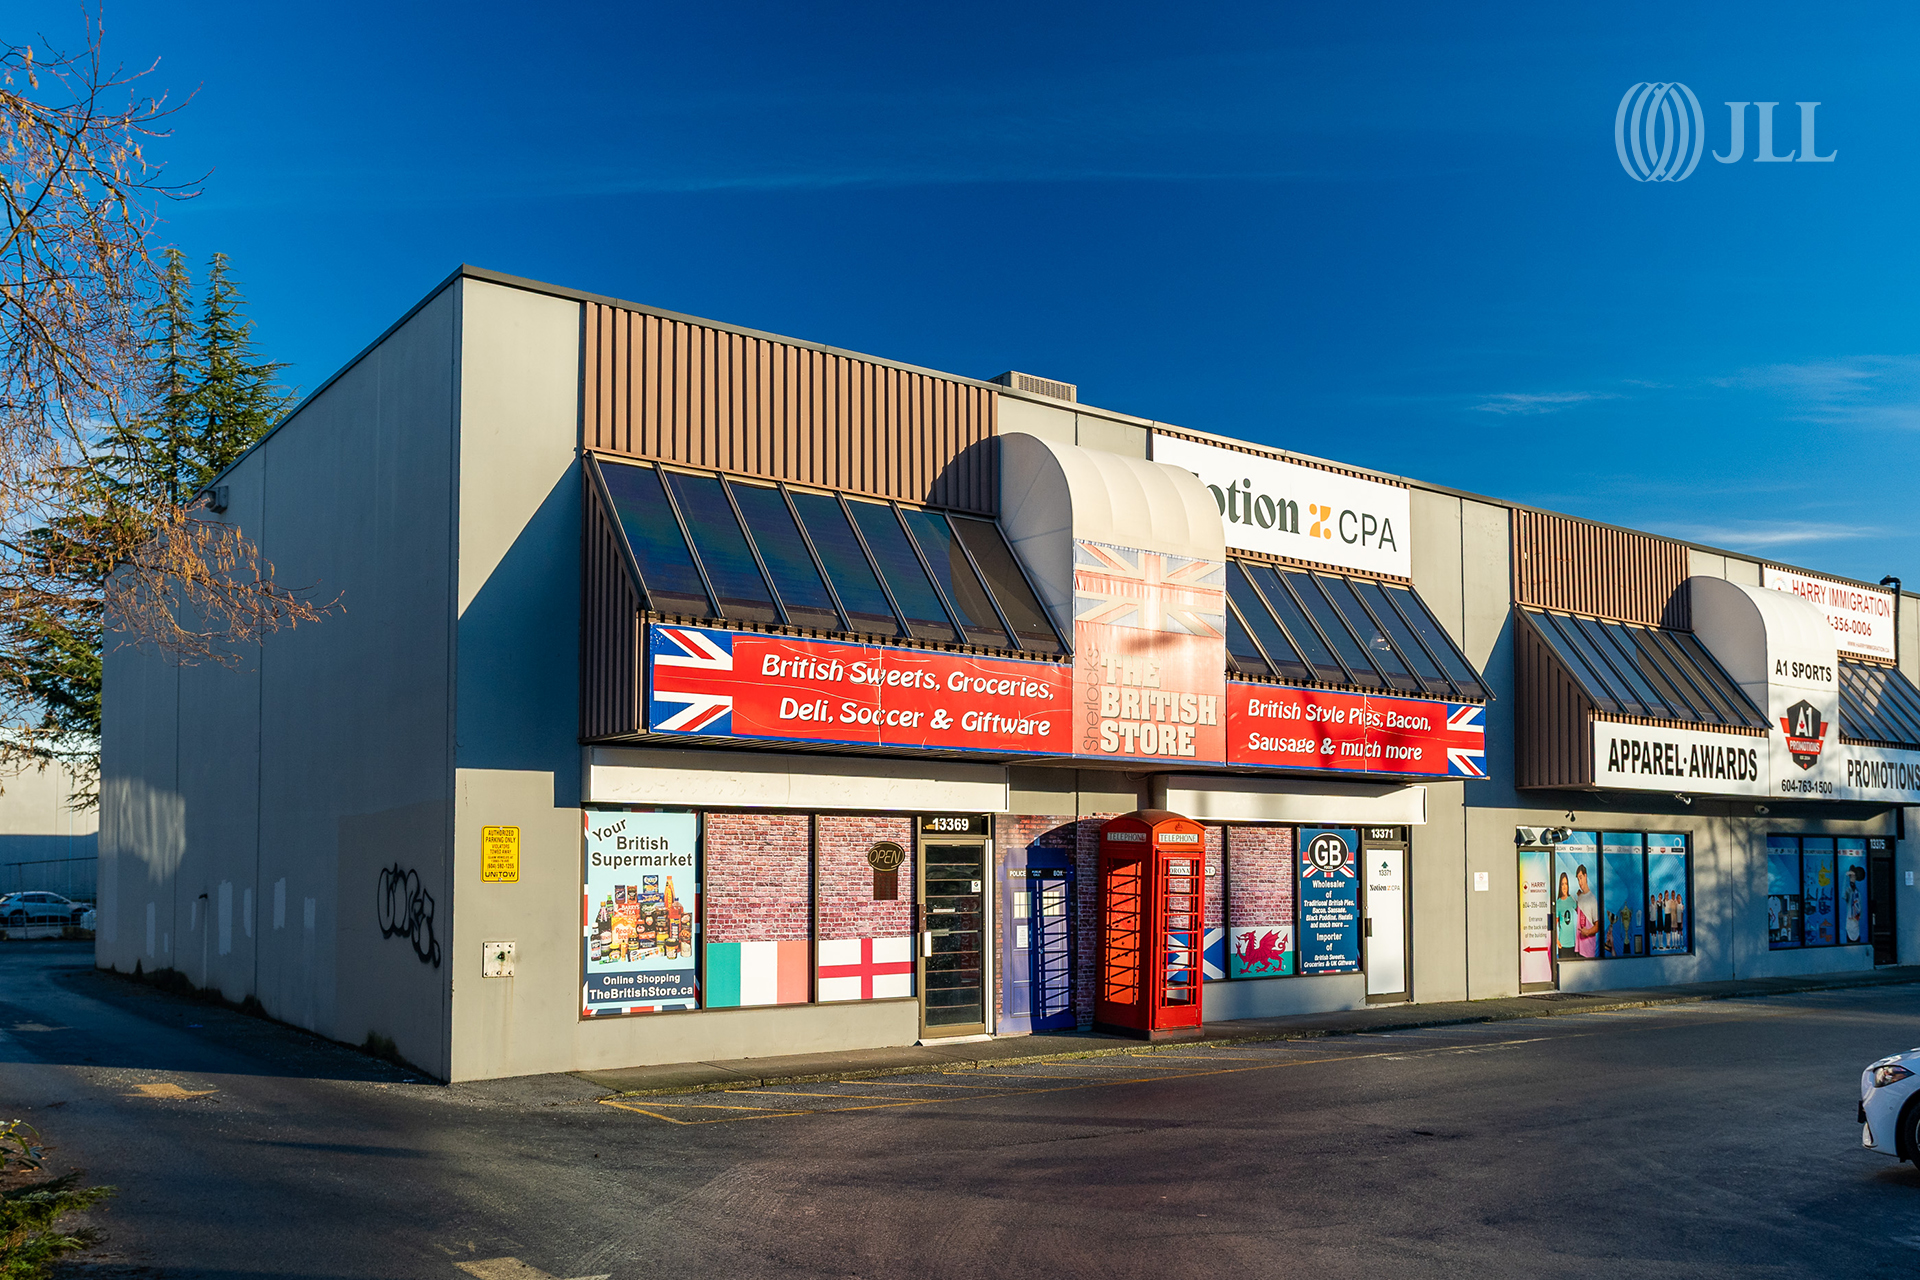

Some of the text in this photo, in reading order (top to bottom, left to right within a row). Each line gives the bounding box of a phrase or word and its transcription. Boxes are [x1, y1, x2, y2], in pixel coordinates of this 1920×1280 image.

[1206, 477, 1397, 552] otion CPA
[1792, 579, 1890, 618] HARRY IMMIGRATION
[761, 653, 1054, 701] British Sweets, Groceries,
[1101, 653, 1161, 688] THE
[1775, 659, 1832, 683] A1 SPORTS
[1083, 647, 1099, 752] Sherlock's
[1100, 686, 1218, 726] BRITISH
[779, 697, 1051, 737] Deli, Soccer & Giftware
[1248, 699, 1432, 732] British Style Pies, Bacon,
[1795, 706, 1813, 737] A1
[1100, 720, 1196, 757] STORE
[1789, 740, 1820, 752] PROMOTIONS
[1248, 732, 1422, 761] Sausage & much more
[1847, 759, 1920, 791] PROMOTIONS
[1781, 779, 1833, 794] 604-763-1500
[592, 819, 626, 841] Your
[932, 817, 969, 831] 13369
[1109, 833, 1145, 841] TELEPHONE
[1160, 834, 1196, 842] TELEPHONE
[1371, 828, 1394, 839] 13371
[617, 836, 669, 850] British
[1869, 838, 1886, 850] 13375
[869, 849, 901, 864] OPEN
[1314, 839, 1342, 866] GB
[592, 852, 692, 870] Supermarket
[1169, 866, 1190, 874] ORONA
[1312, 880, 1345, 888] Wholesaler
[1325, 890, 1333, 899] of
[1304, 899, 1328, 907] Traditional
[1316, 932, 1343, 942] Importer
[1326, 943, 1333, 951] of
[603, 974, 681, 985] Online Shopping
[589, 986, 693, 1000] TheBritishStore.ca
